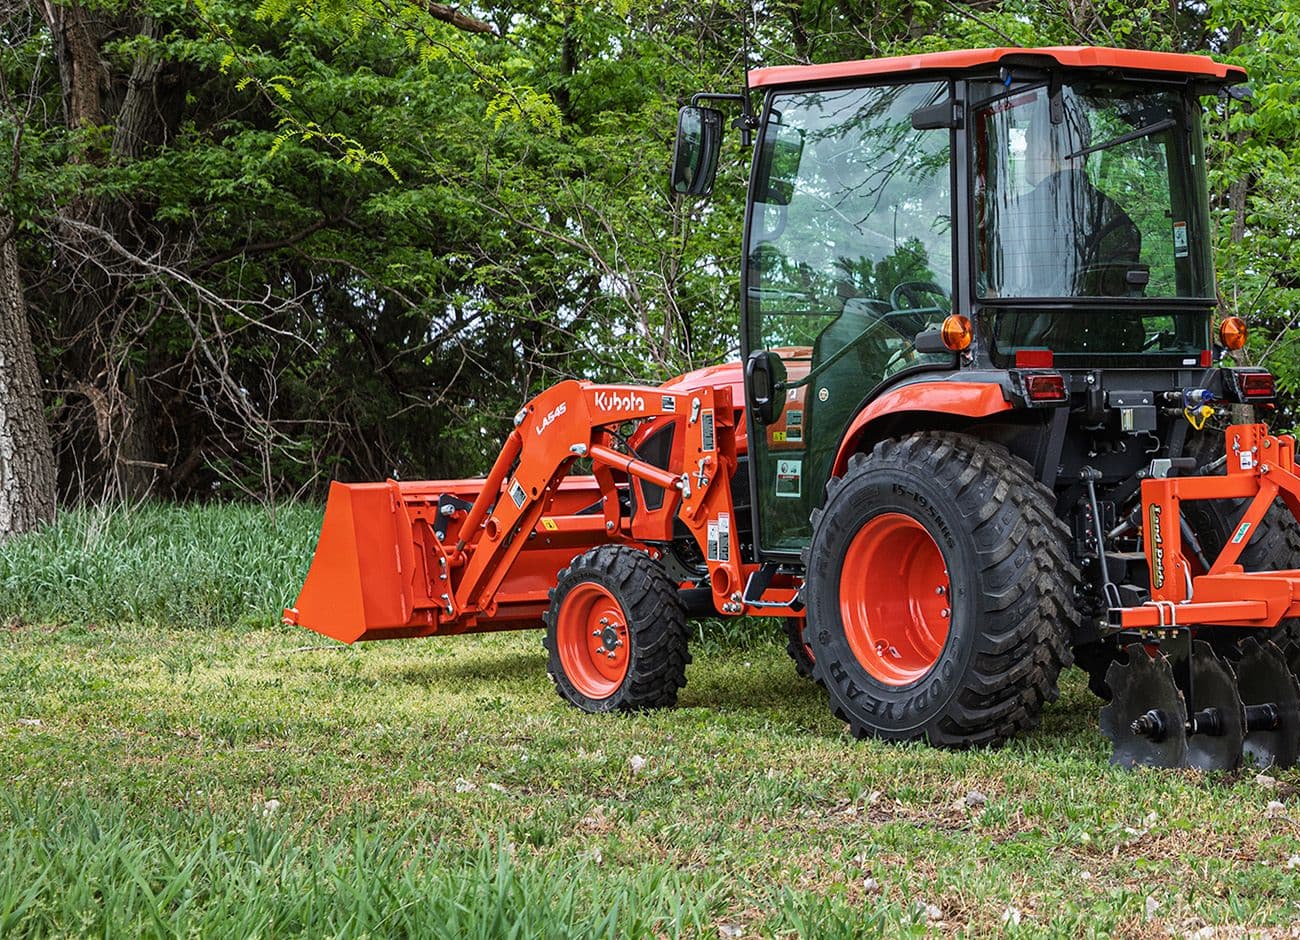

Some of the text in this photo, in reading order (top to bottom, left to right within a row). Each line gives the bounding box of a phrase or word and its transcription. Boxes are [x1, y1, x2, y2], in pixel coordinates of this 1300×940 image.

[536, 401, 567, 435] LA545
[595, 392, 645, 411] Kubota
[1153, 505, 1165, 588] Land Pride
